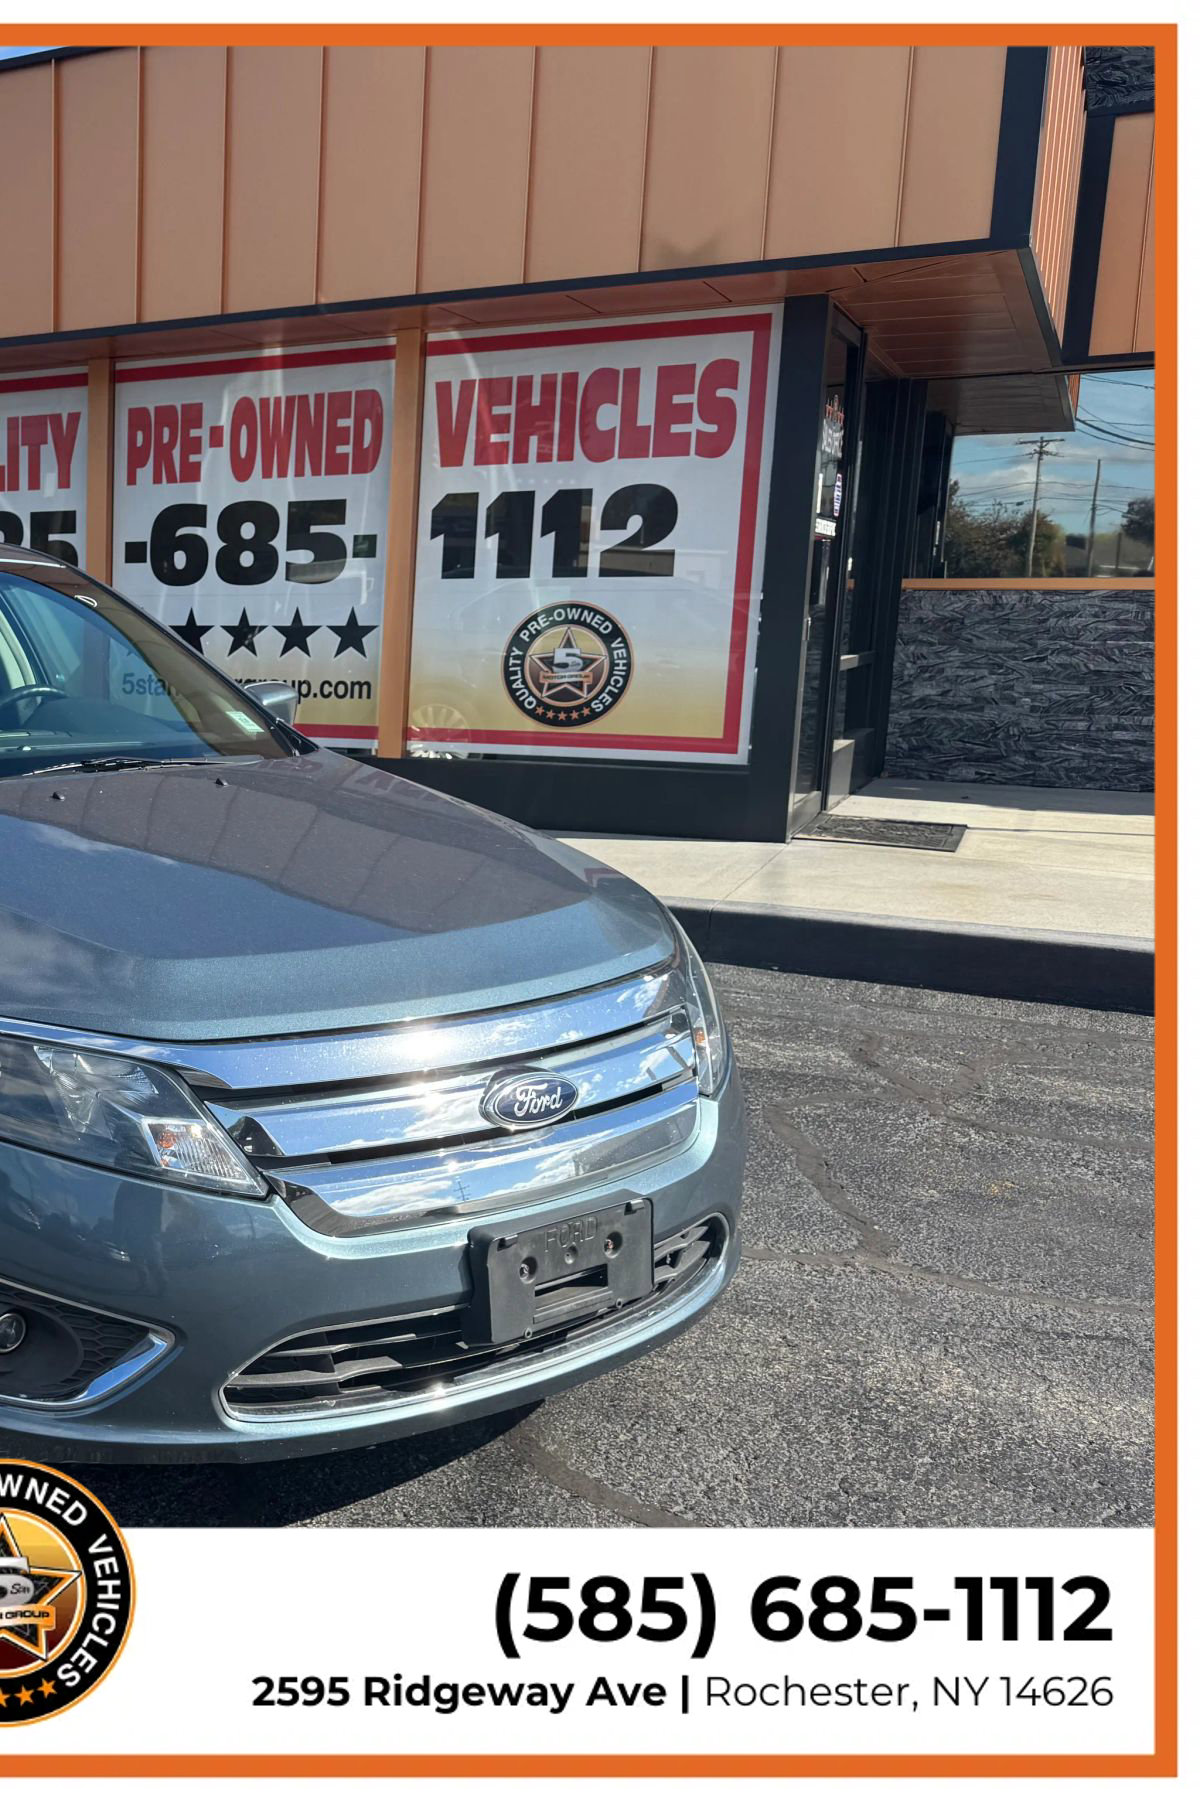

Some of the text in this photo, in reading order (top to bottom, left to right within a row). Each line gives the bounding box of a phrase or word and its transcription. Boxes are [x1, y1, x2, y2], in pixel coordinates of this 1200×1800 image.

[126, 389, 384, 486] PRE-OWNED
[434, 358, 740, 468] VEHICLES
[430, 483, 678, 579] 1112
[509, 607, 628, 712] QUALITY PRE-OWNED VEHICLES
[514, 1081, 564, 1118] Ford
[544, 1216, 599, 1254] FORD
